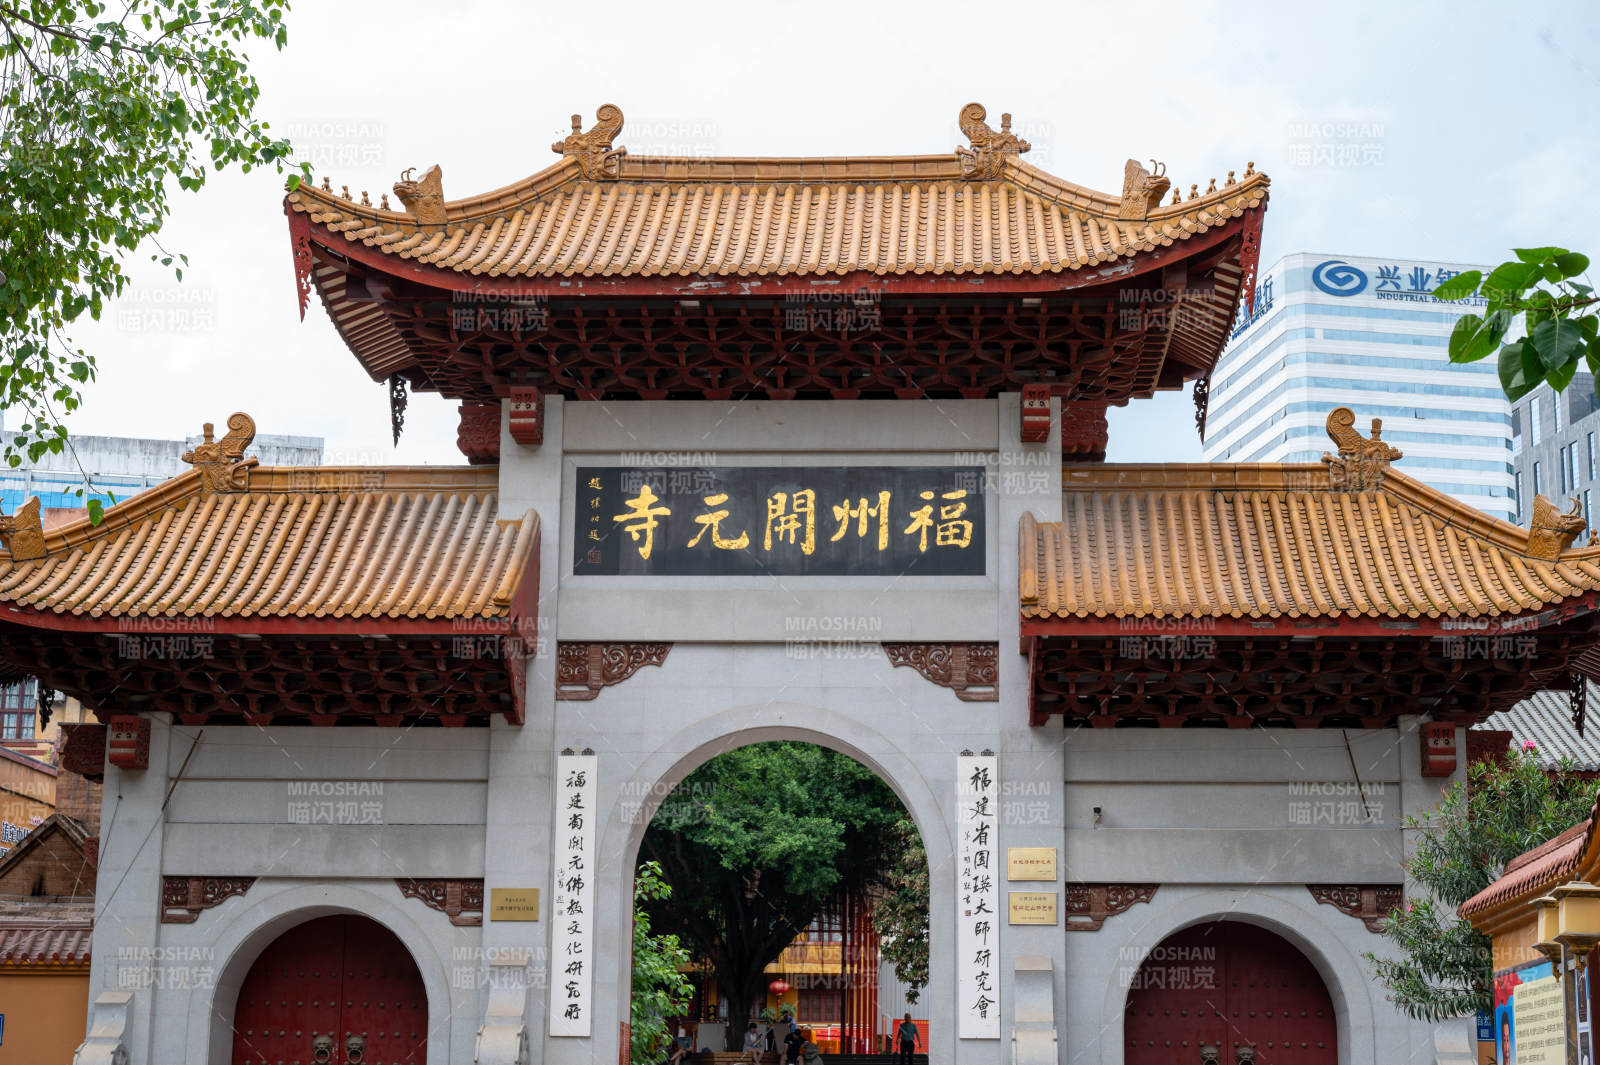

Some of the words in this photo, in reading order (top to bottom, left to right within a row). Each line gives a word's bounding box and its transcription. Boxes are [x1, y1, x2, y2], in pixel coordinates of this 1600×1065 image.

[1375, 264, 1490, 297] 兴业
[1377, 292, 1430, 303] INDUSTRIAL
[613, 484, 973, 560] 福州開元寺
